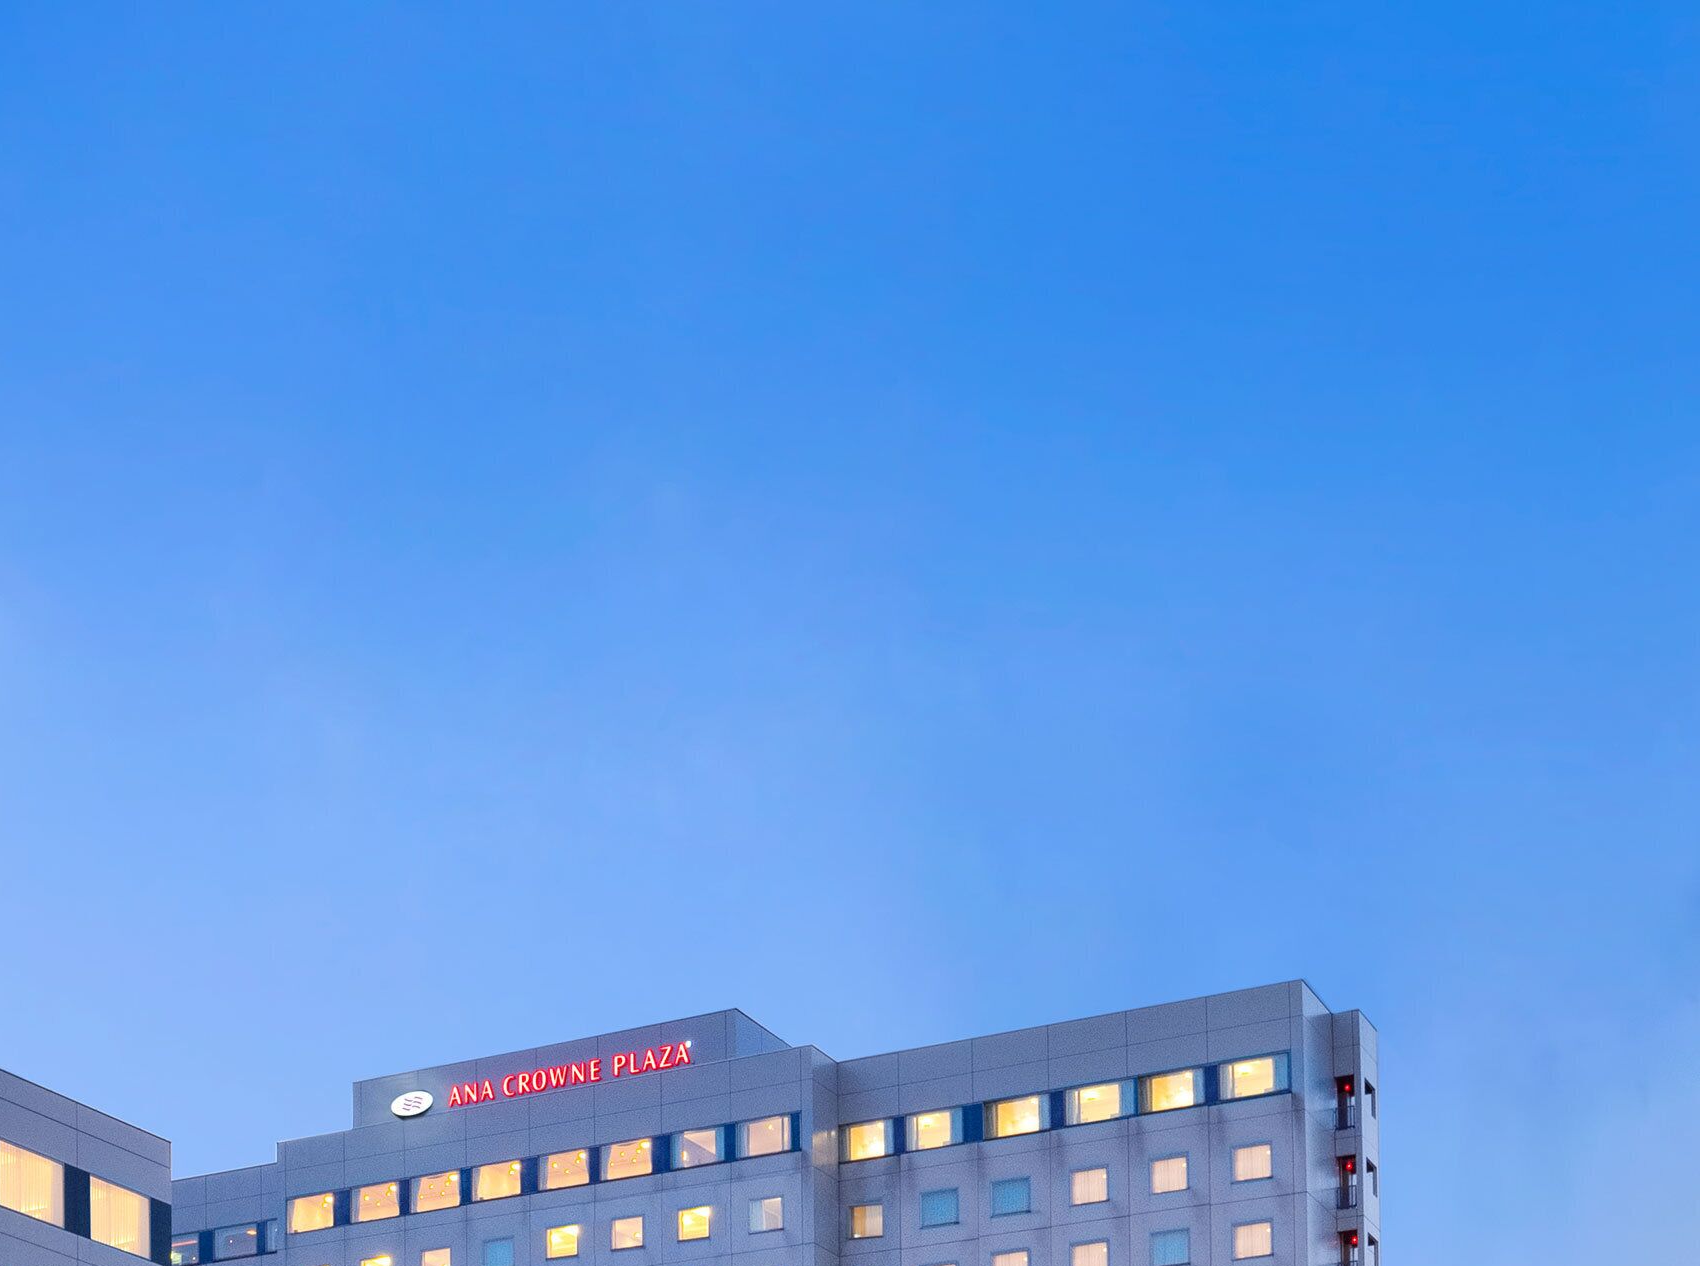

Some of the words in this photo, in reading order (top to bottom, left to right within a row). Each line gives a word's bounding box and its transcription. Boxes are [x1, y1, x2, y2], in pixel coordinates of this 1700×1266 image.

[449, 1082, 495, 1107] ANA
[502, 1058, 602, 1097] CROWNE
[613, 1042, 691, 1077] PLAZA
